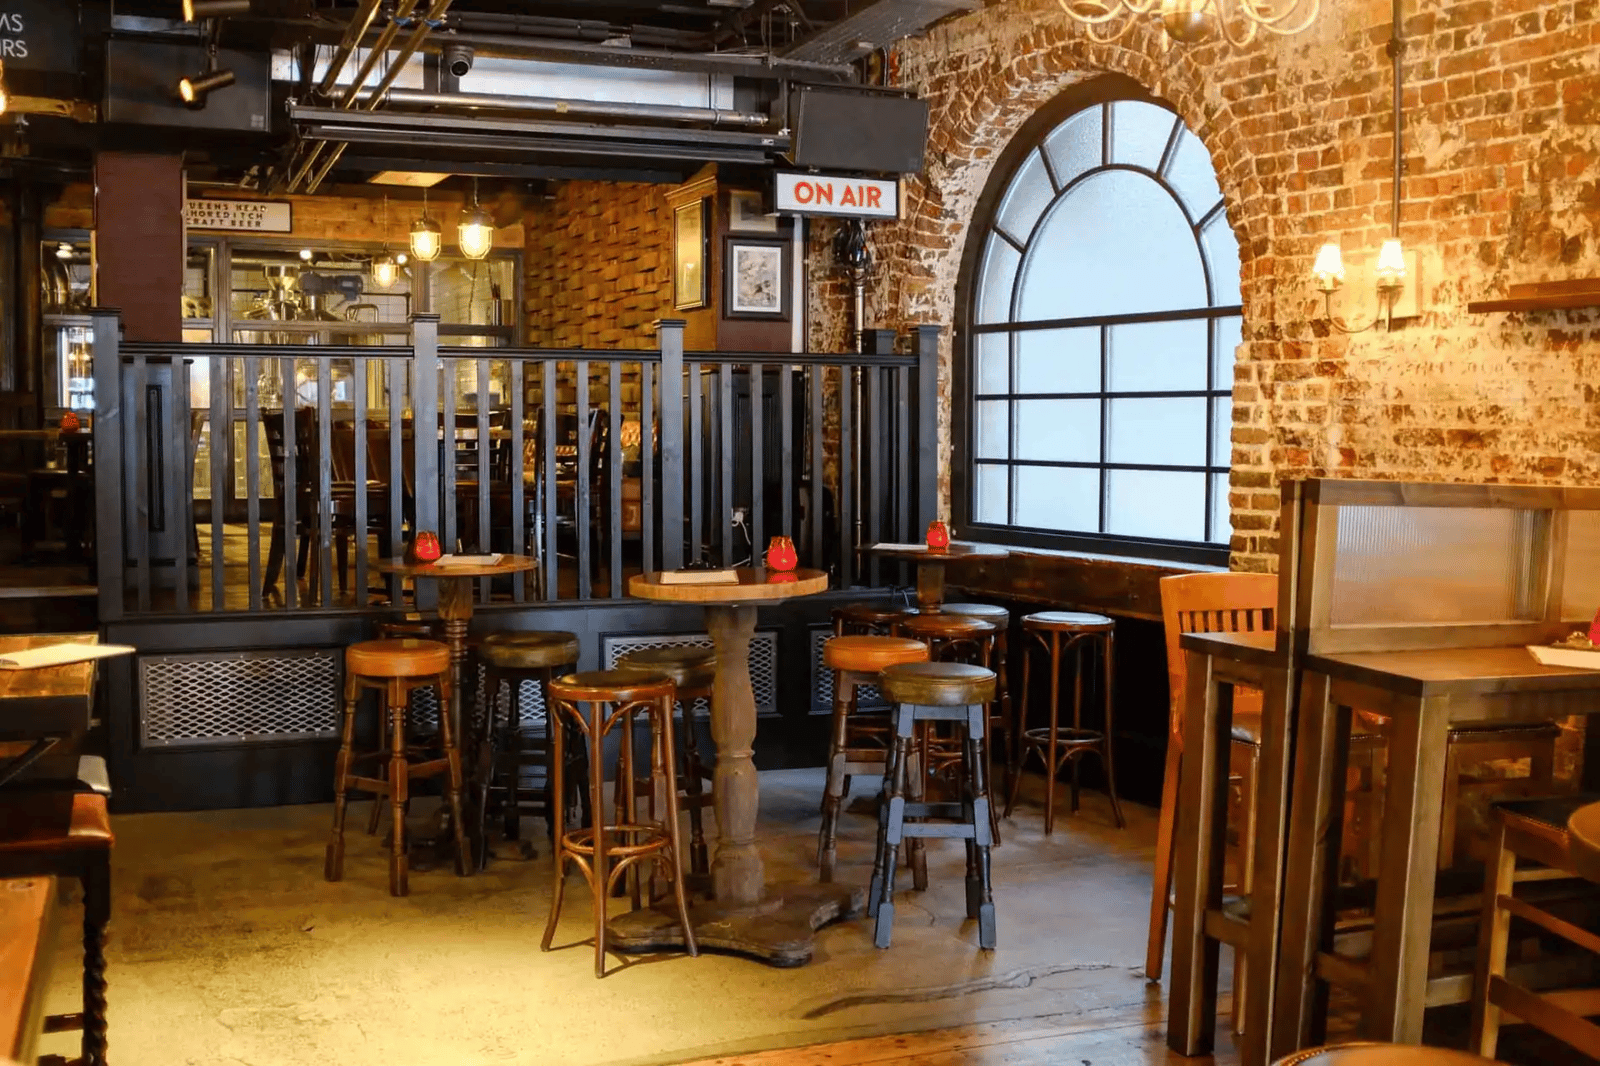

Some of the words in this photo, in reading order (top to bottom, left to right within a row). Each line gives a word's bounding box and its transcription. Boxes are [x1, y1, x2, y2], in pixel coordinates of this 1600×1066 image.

[794, 181, 833, 205] ON
[840, 185, 882, 208] AIR
[188, 202, 229, 210] UEENS
[236, 204, 267, 213] HEAD
